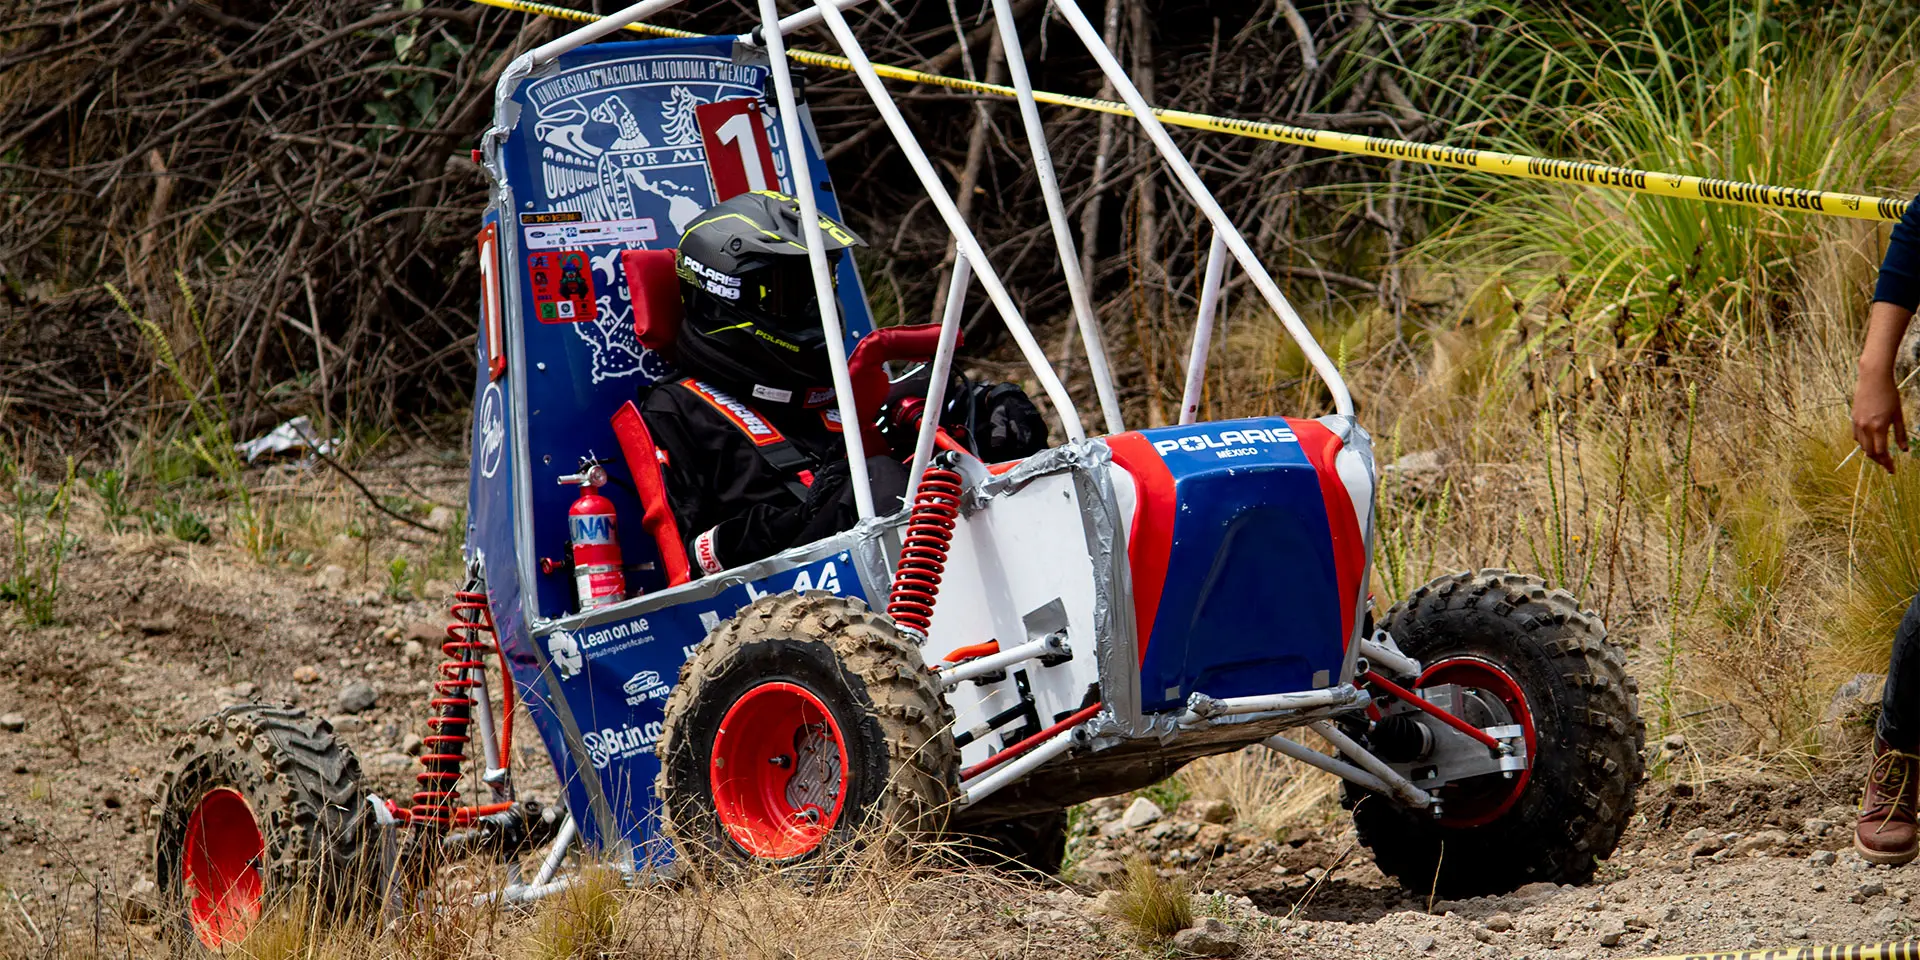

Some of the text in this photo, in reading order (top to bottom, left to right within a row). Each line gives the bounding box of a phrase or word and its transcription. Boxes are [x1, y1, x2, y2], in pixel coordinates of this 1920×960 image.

[535, 70, 599, 105] UNIVERSIDAD
[600, 64, 650, 85] NACIONAL
[651, 61, 706, 80] AUTONOMA
[620, 148, 705, 167] POR MI
[715, 113, 767, 192] 1
[1364, 137, 1479, 167] PRECAUCION
[1528, 156, 1647, 190] PRECAUCION
[1699, 177, 1825, 212] PRECAUCION
[684, 255, 742, 287] POLARIS
[706, 280, 741, 300] 509
[755, 329, 800, 352] POLARIS
[1153, 427, 1299, 457] POLARIS
[1216, 447, 1258, 460] MÉXICO
[579, 628, 613, 650] Lean
[613, 624, 630, 640] on
[648, 685, 670, 700] AUTO
